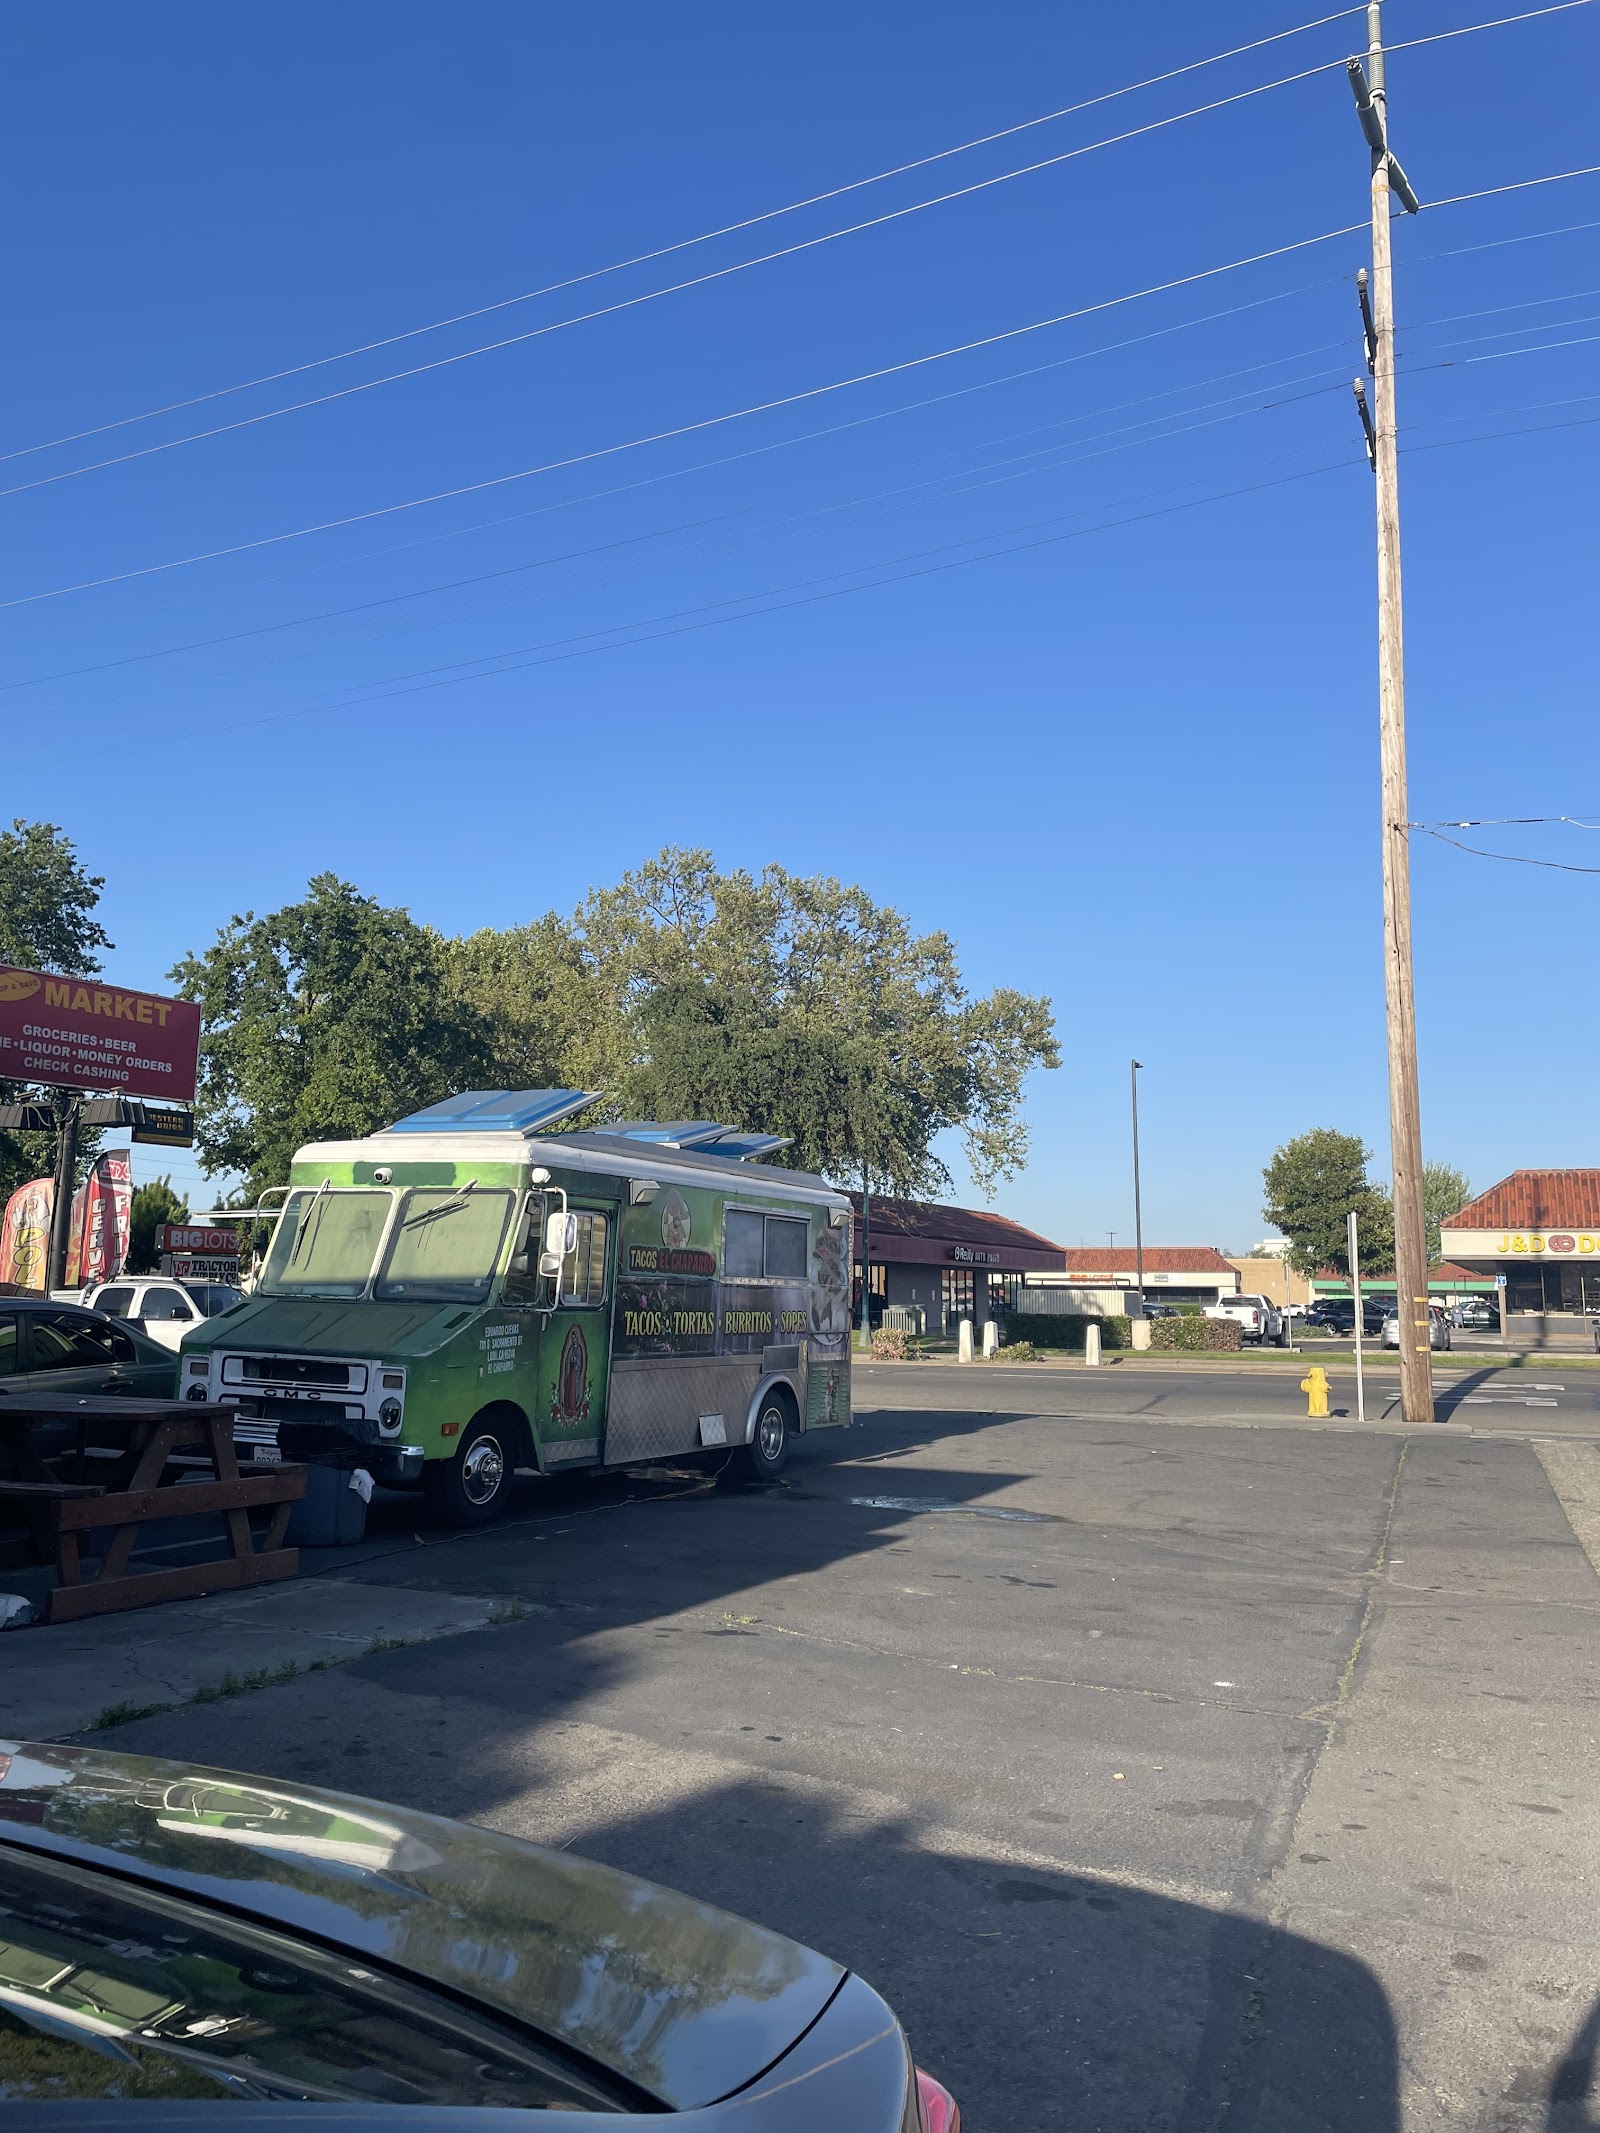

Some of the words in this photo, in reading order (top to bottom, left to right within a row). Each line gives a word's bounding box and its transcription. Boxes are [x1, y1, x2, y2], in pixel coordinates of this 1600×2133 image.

[19, 979, 39, 989] SAVE
[44, 981, 172, 1027] MARKET
[22, 1024, 98, 1046] GROCERIES
[104, 1038, 137, 1053] BEER
[19, 1040, 71, 1057] LIQUOR
[77, 1049, 123, 1065] MONEY
[125, 1056, 173, 1073] ORDERS
[23, 1057, 70, 1073] CHECK
[73, 1064, 130, 1081] CASHING
[156, 1122, 184, 1131] UNION
[170, 1230, 203, 1249] BIG
[1497, 1234, 1546, 1252] J&D
[192, 1260, 237, 1272] TRACTOR
[630, 1249, 658, 1270] TACOS
[659, 1251, 670, 1270] EL
[671, 1253, 716, 1274] CHAPARRO
[624, 1311, 661, 1336] TACOS
[673, 1311, 715, 1335] TORTAS
[725, 1311, 772, 1334] BURRITOS
[780, 1311, 807, 1333] SOPES
[263, 1389, 322, 1400] GMC
